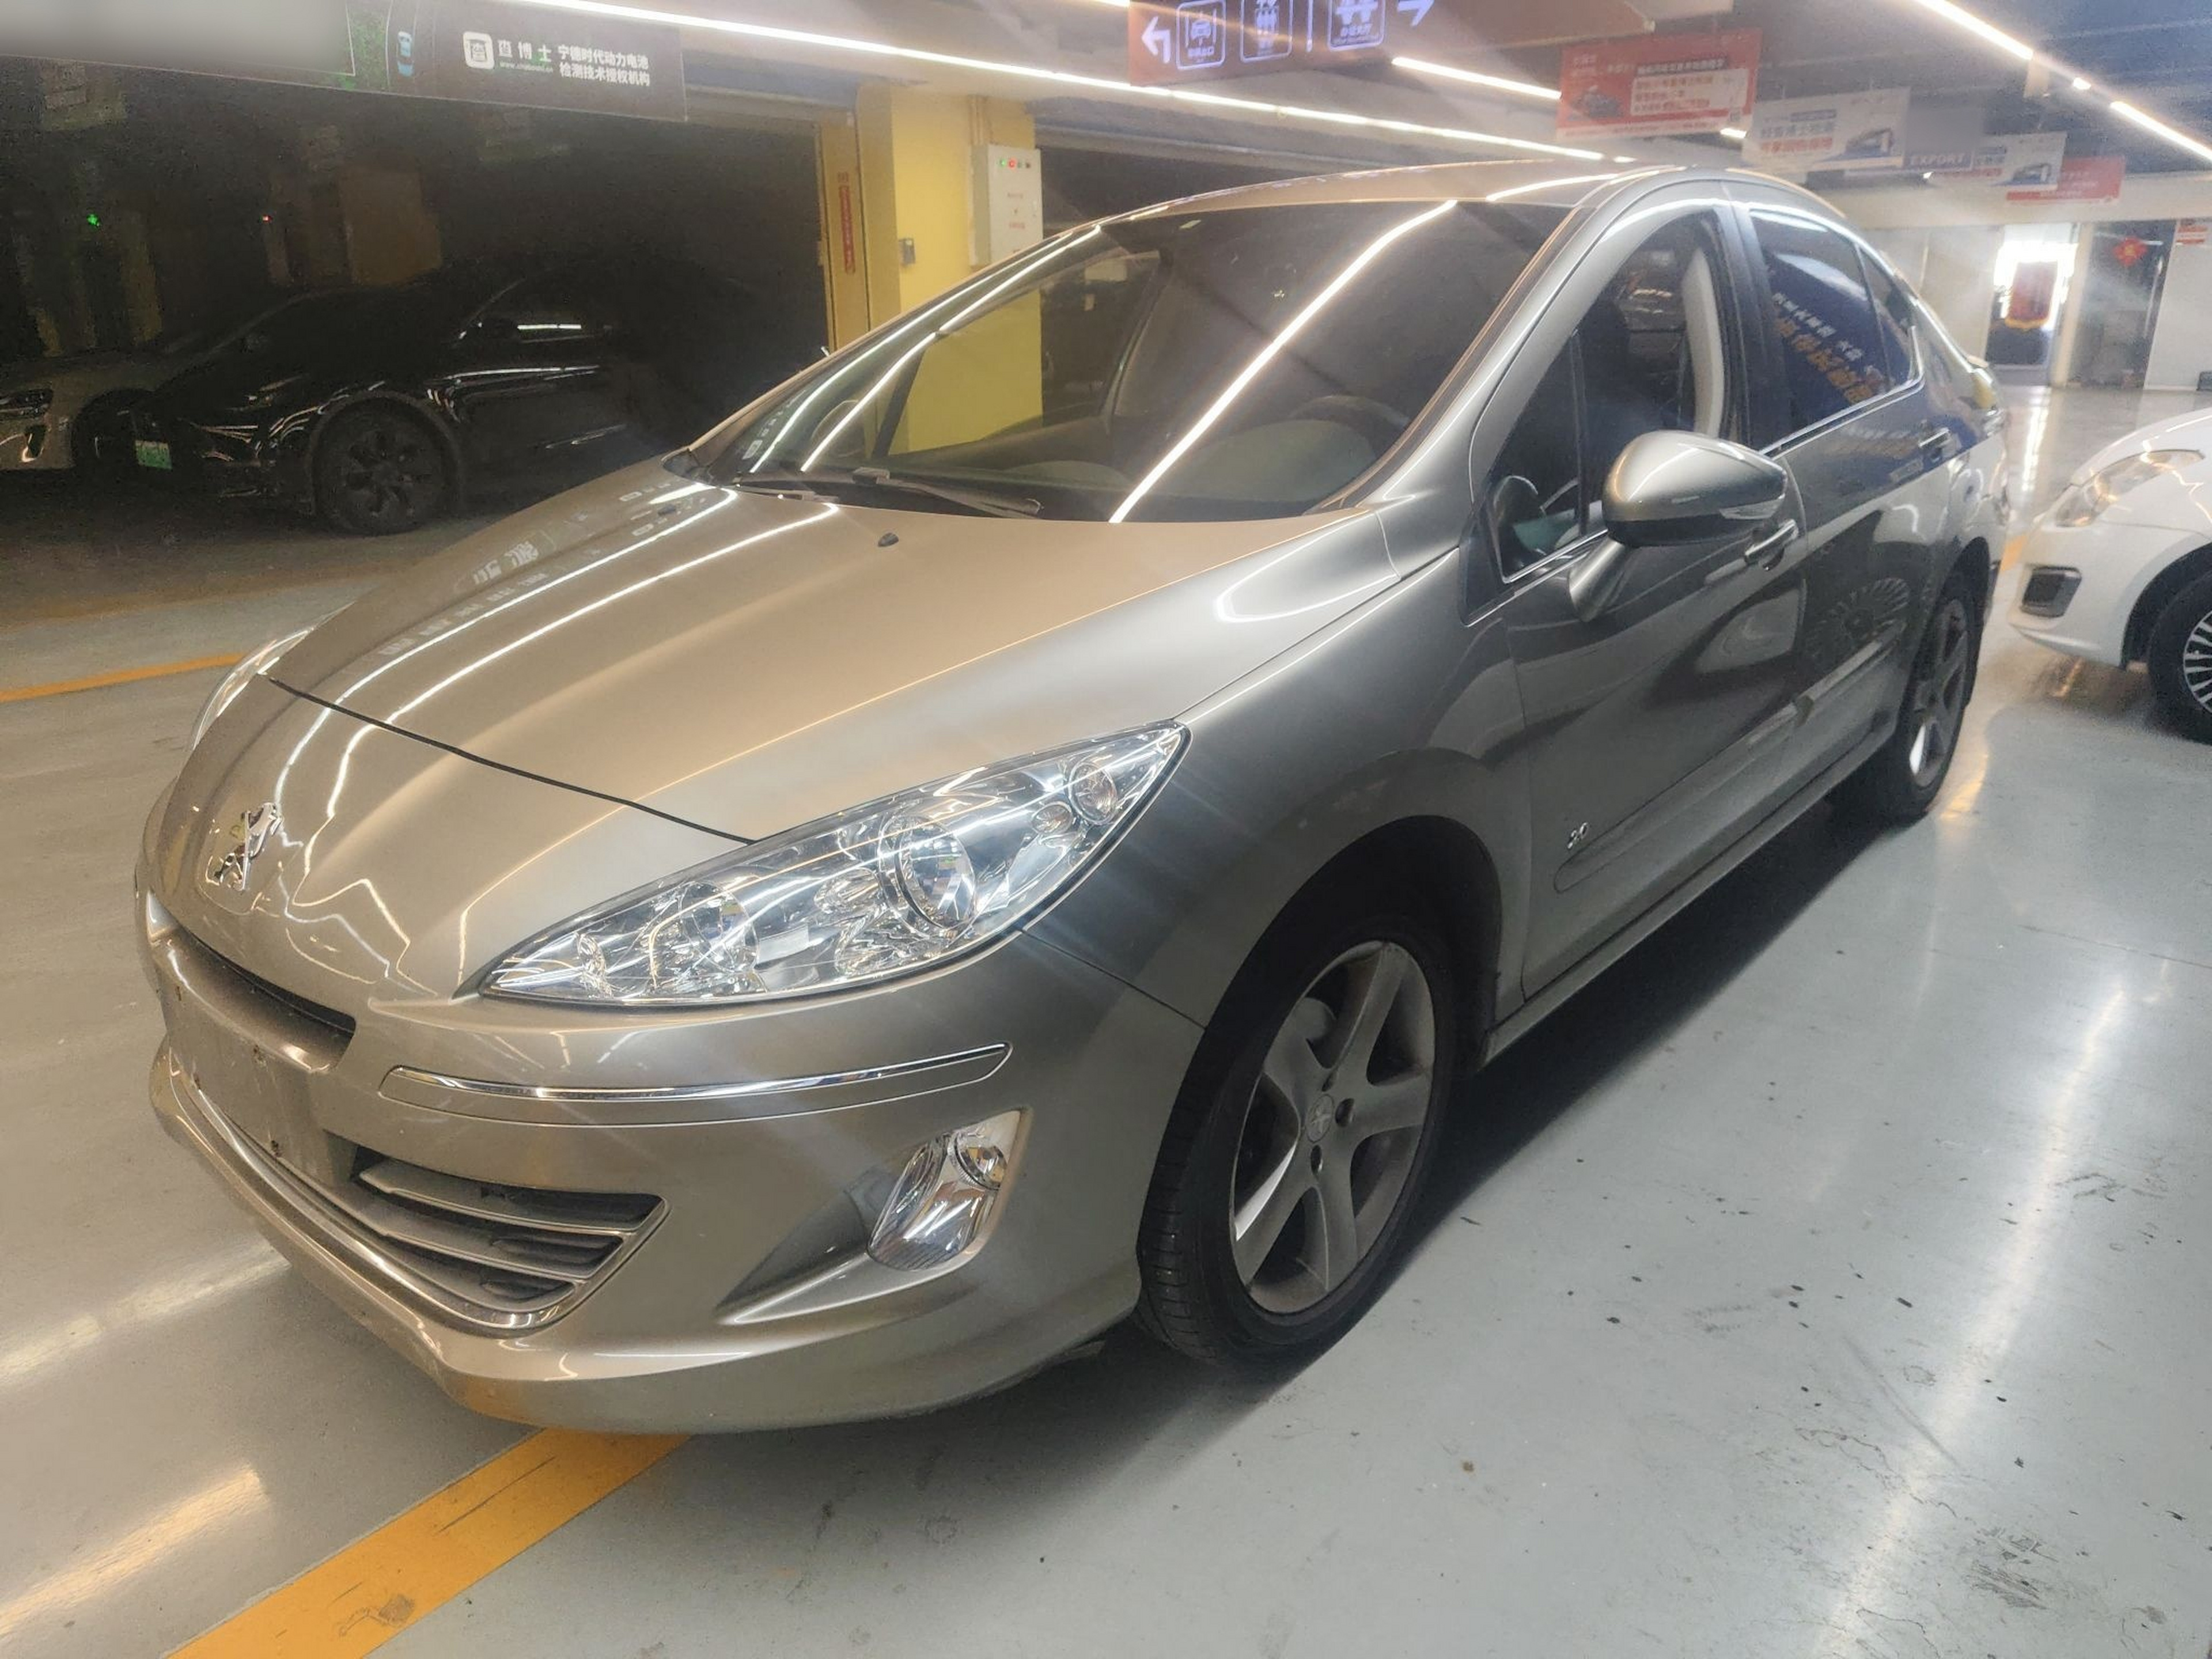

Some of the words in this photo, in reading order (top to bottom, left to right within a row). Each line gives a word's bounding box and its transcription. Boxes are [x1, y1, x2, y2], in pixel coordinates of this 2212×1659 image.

[497, 39, 552, 62] 查博士
[558, 44, 649, 70] 宁德时代动力电池
[559, 62, 650, 86] 检测技术授权机构
